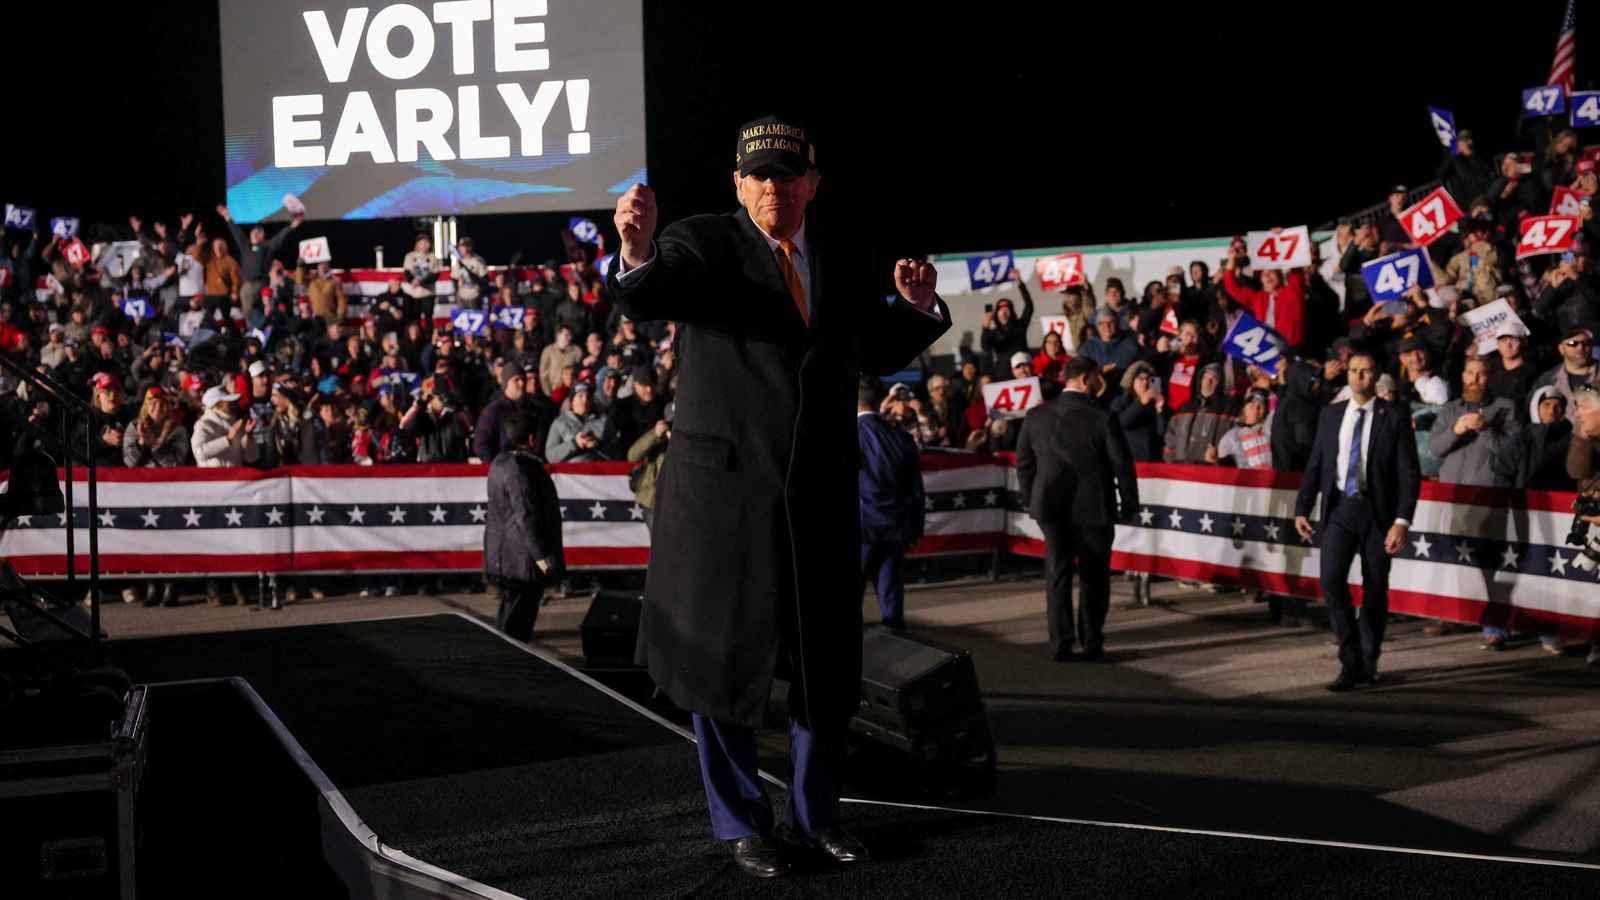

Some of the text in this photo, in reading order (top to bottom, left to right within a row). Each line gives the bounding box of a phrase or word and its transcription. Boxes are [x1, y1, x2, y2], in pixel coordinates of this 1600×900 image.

[303, 0, 549, 83] VOTE
[1525, 88, 1559, 112] 47
[1577, 96, 1600, 121] 4
[272, 78, 591, 168] EARLY!
[743, 124, 765, 141] MAKE
[746, 138, 800, 154] GREAT AGAIN
[1557, 192, 1580, 215] 4
[1411, 196, 1446, 240] 47
[1521, 219, 1572, 248] 47
[1257, 235, 1299, 261] 47
[973, 255, 1009, 283] 47
[1041, 257, 1077, 283] 47
[1375, 254, 1419, 294] 47
[454, 312, 483, 332] 47
[1472, 312, 1507, 332] RUMP
[1233, 326, 1282, 363] 47
[993, 385, 1032, 412] 47
